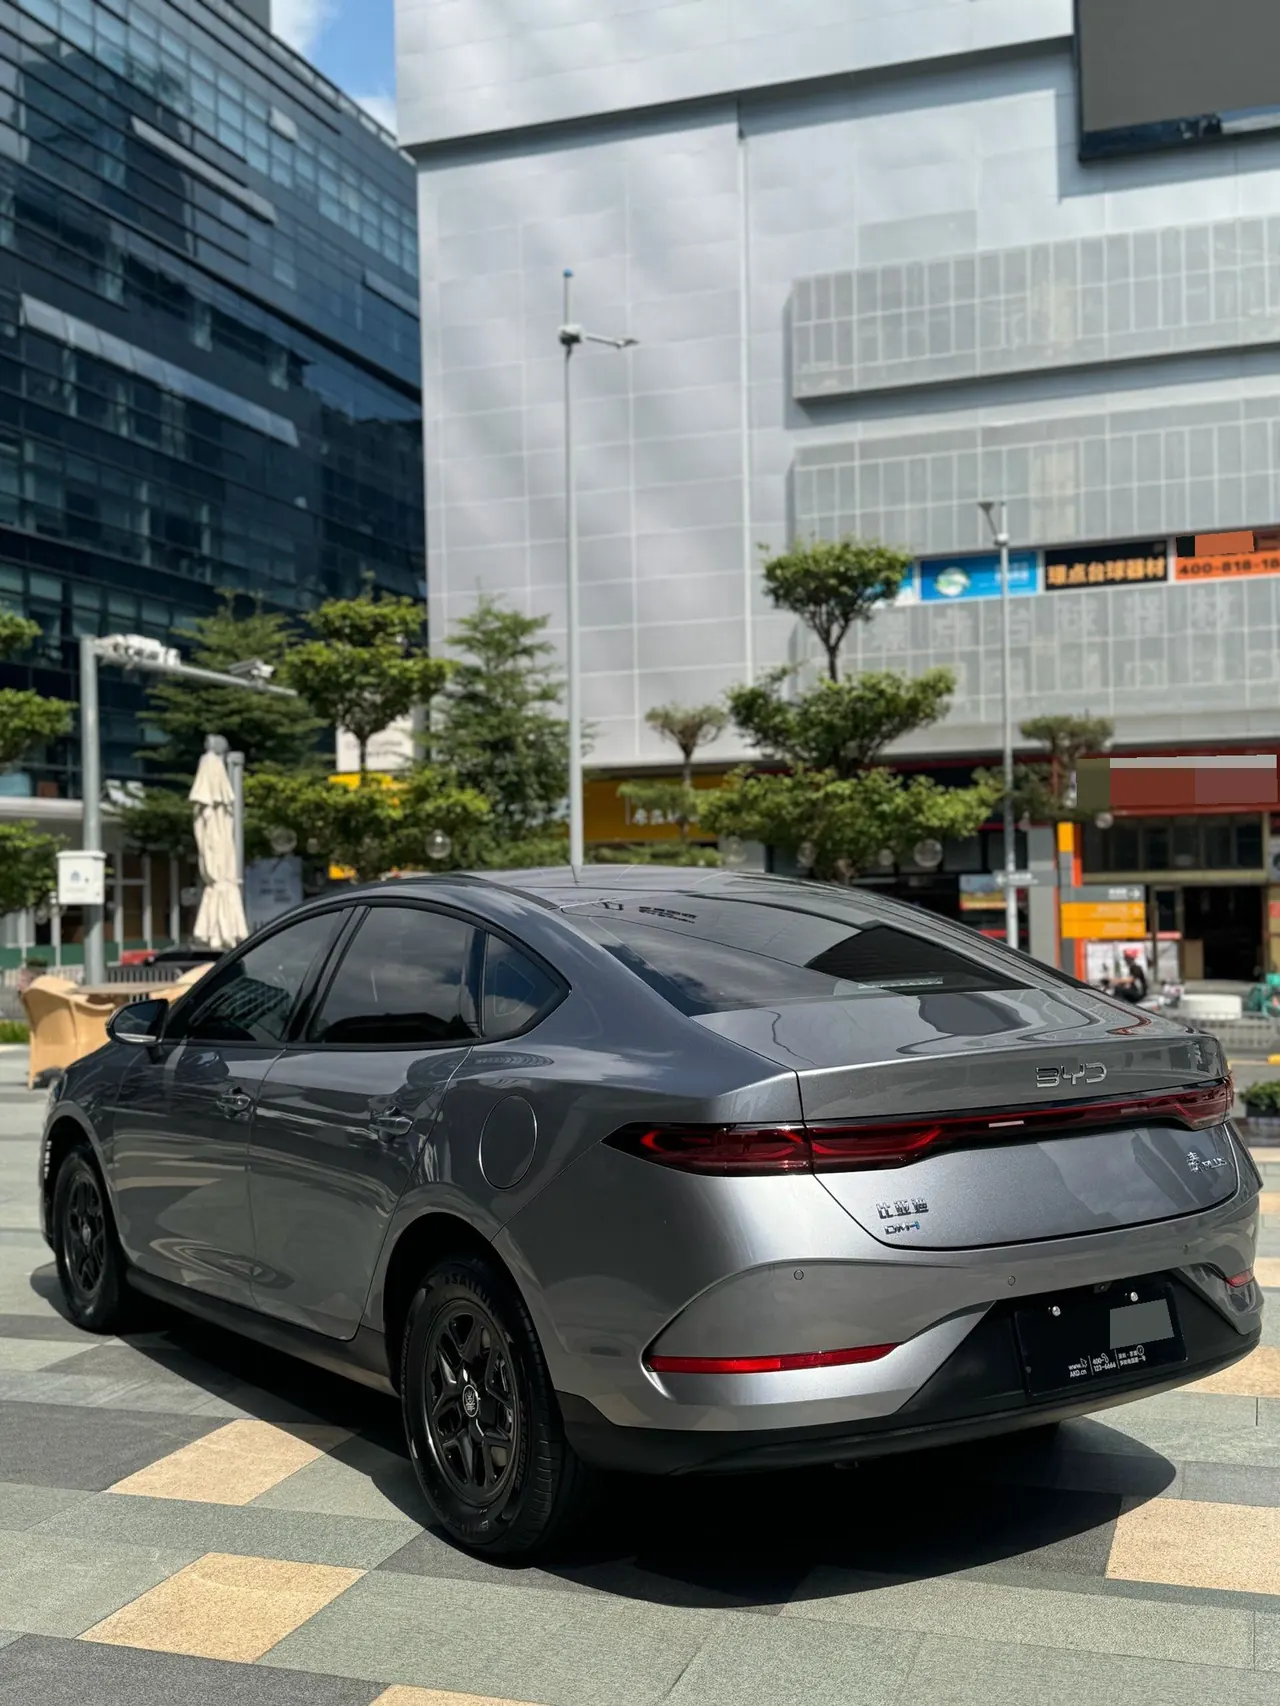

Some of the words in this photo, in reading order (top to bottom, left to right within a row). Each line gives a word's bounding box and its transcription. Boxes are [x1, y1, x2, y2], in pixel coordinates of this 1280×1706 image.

[1036, 1062, 1107, 1088] BYD
[876, 1198, 929, 1219] 比亚迪
